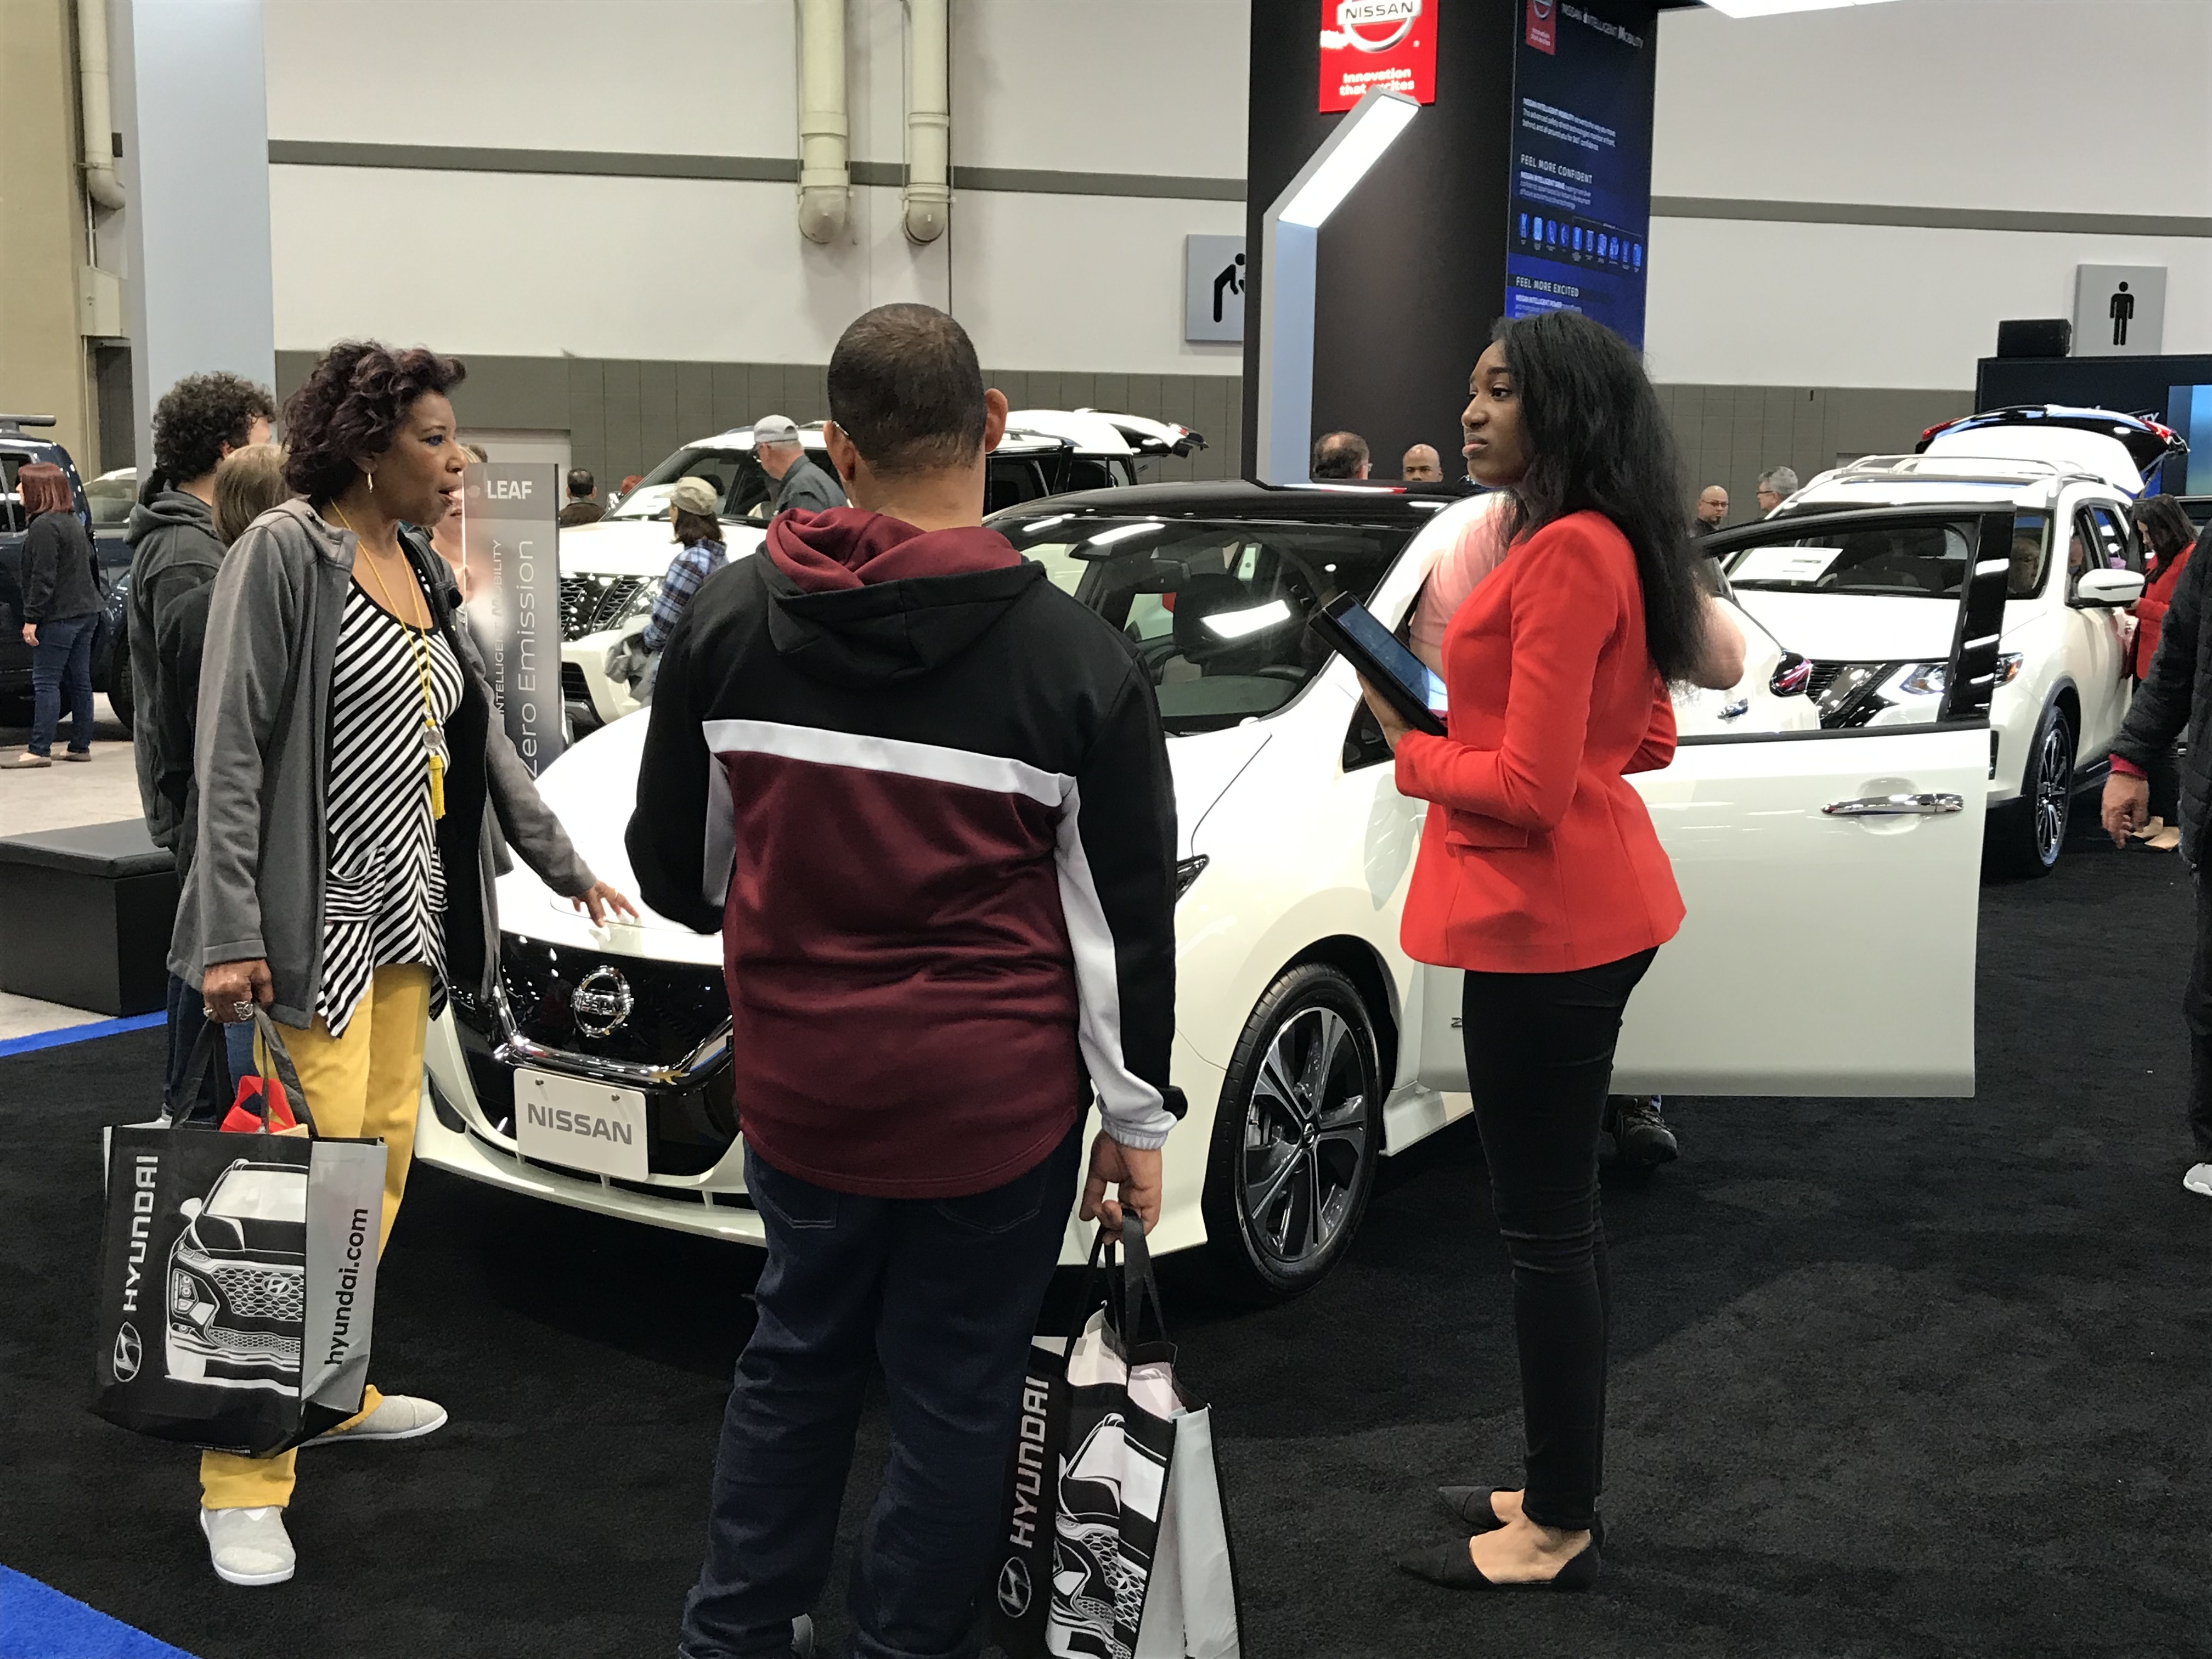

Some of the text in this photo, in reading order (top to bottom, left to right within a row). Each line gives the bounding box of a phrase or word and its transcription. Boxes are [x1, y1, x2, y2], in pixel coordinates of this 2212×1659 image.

[1346, 1, 1413, 19] NISSAN
[1339, 80, 1415, 95] that cites
[1342, 67, 1412, 83] Innovation
[1520, 154, 1593, 184] FEEL MORE CONFIDENT
[1516, 276, 1579, 297] FEEL MORE EXCITED
[487, 481, 532, 500] LEAF
[516, 540, 538, 778] Zero Emission
[527, 1103, 633, 1146] NISSAN
[123, 1155, 159, 1312] HYUNDAI
[324, 1208, 369, 1365] hyundai.com
[1009, 1376, 1049, 1549] HYUNDAI
